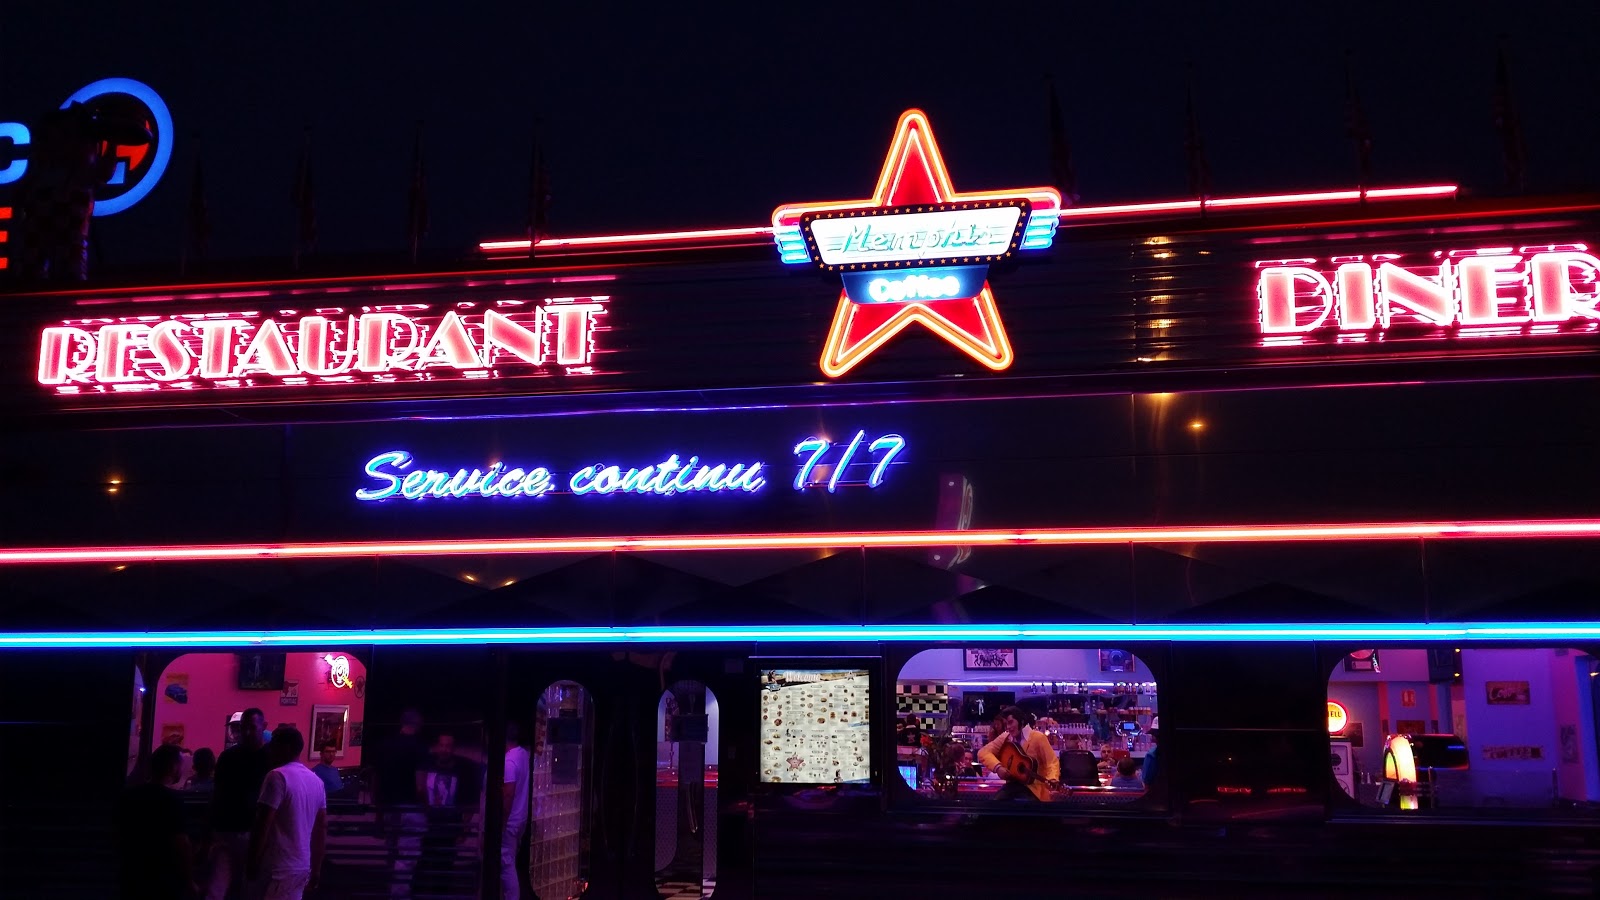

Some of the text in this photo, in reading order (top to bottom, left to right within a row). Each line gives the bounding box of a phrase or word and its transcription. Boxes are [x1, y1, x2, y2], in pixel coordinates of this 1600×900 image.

[842, 218, 993, 258] Memphis
[1259, 252, 1600, 334] DINER
[37, 303, 605, 385] RESTAURANT
[355, 429, 906, 501] Service continu 7/7
